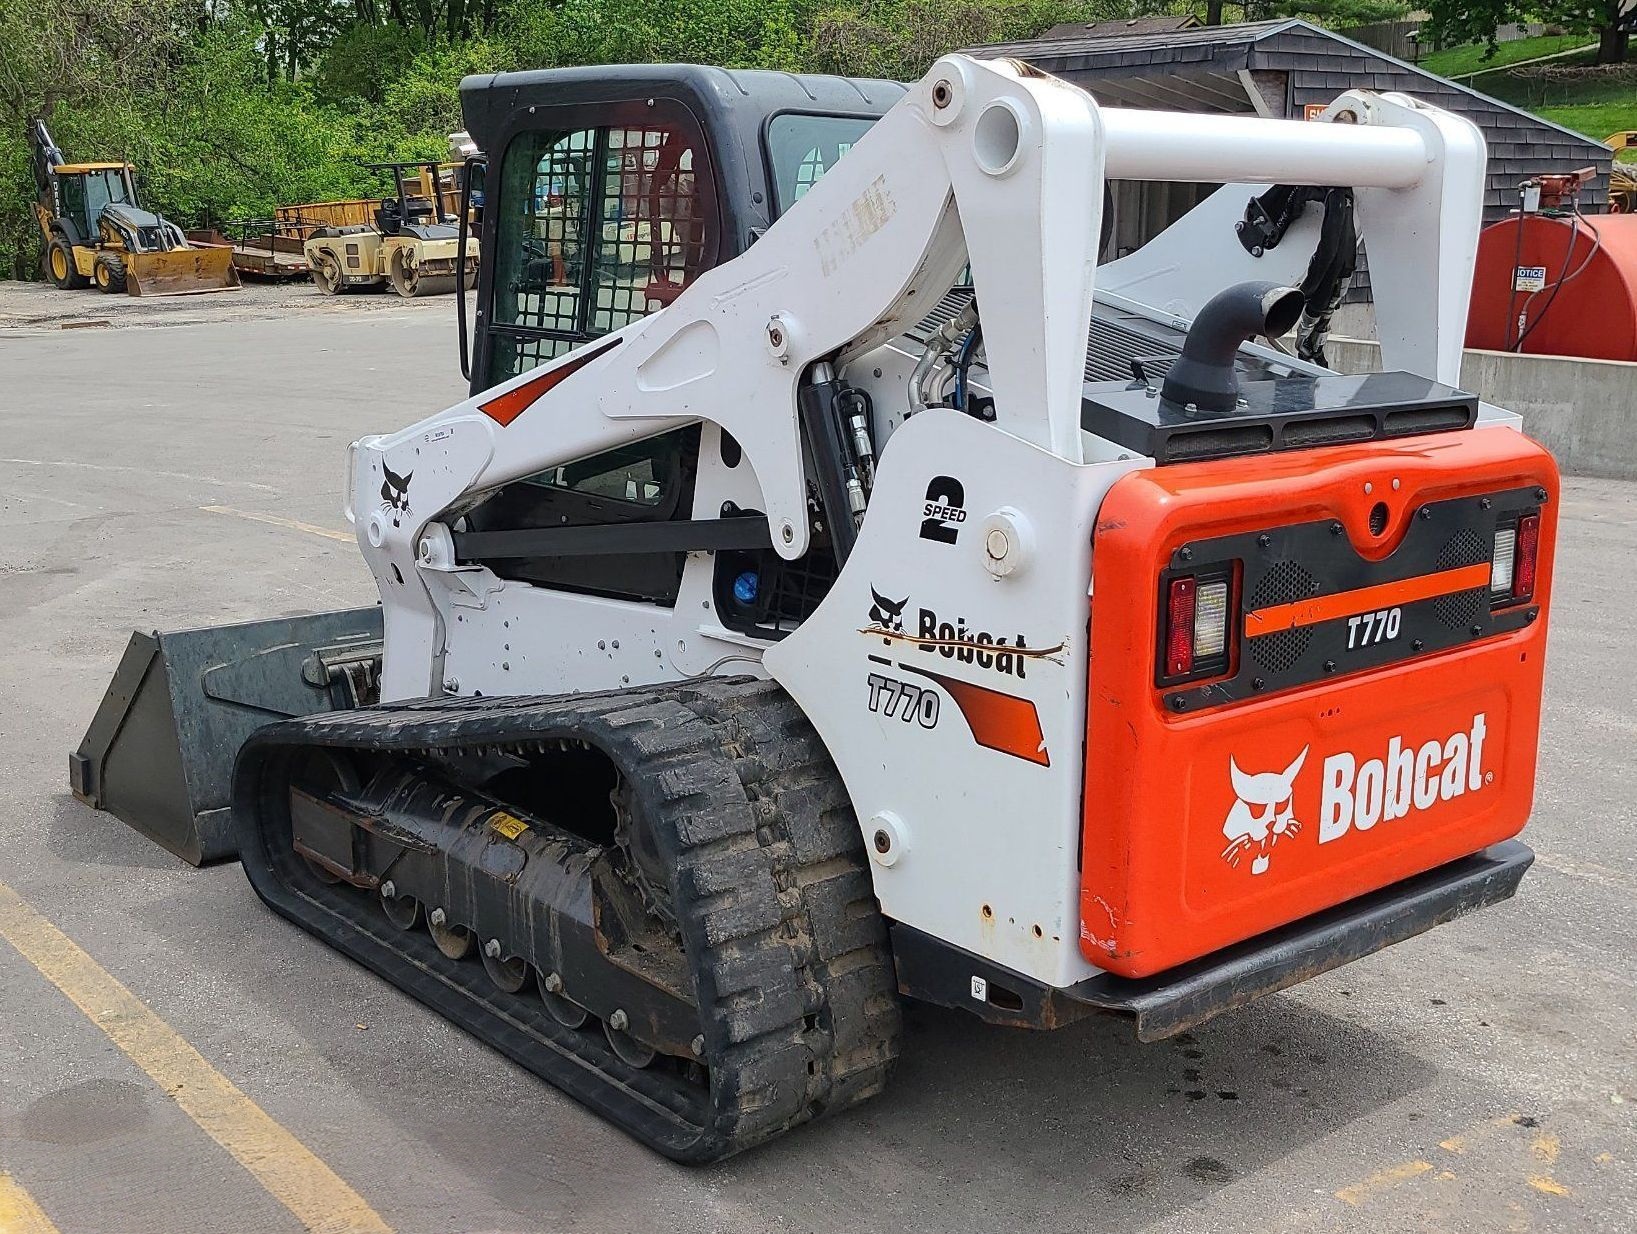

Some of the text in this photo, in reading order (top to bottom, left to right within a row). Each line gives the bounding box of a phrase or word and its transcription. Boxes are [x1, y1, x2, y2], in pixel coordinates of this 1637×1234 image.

[923, 503, 967, 524] SPEED
[918, 607, 1027, 680] Bobcat
[1347, 607, 1401, 649] T770
[867, 672, 940, 730] T770
[1318, 713, 1487, 845] Bobcat
